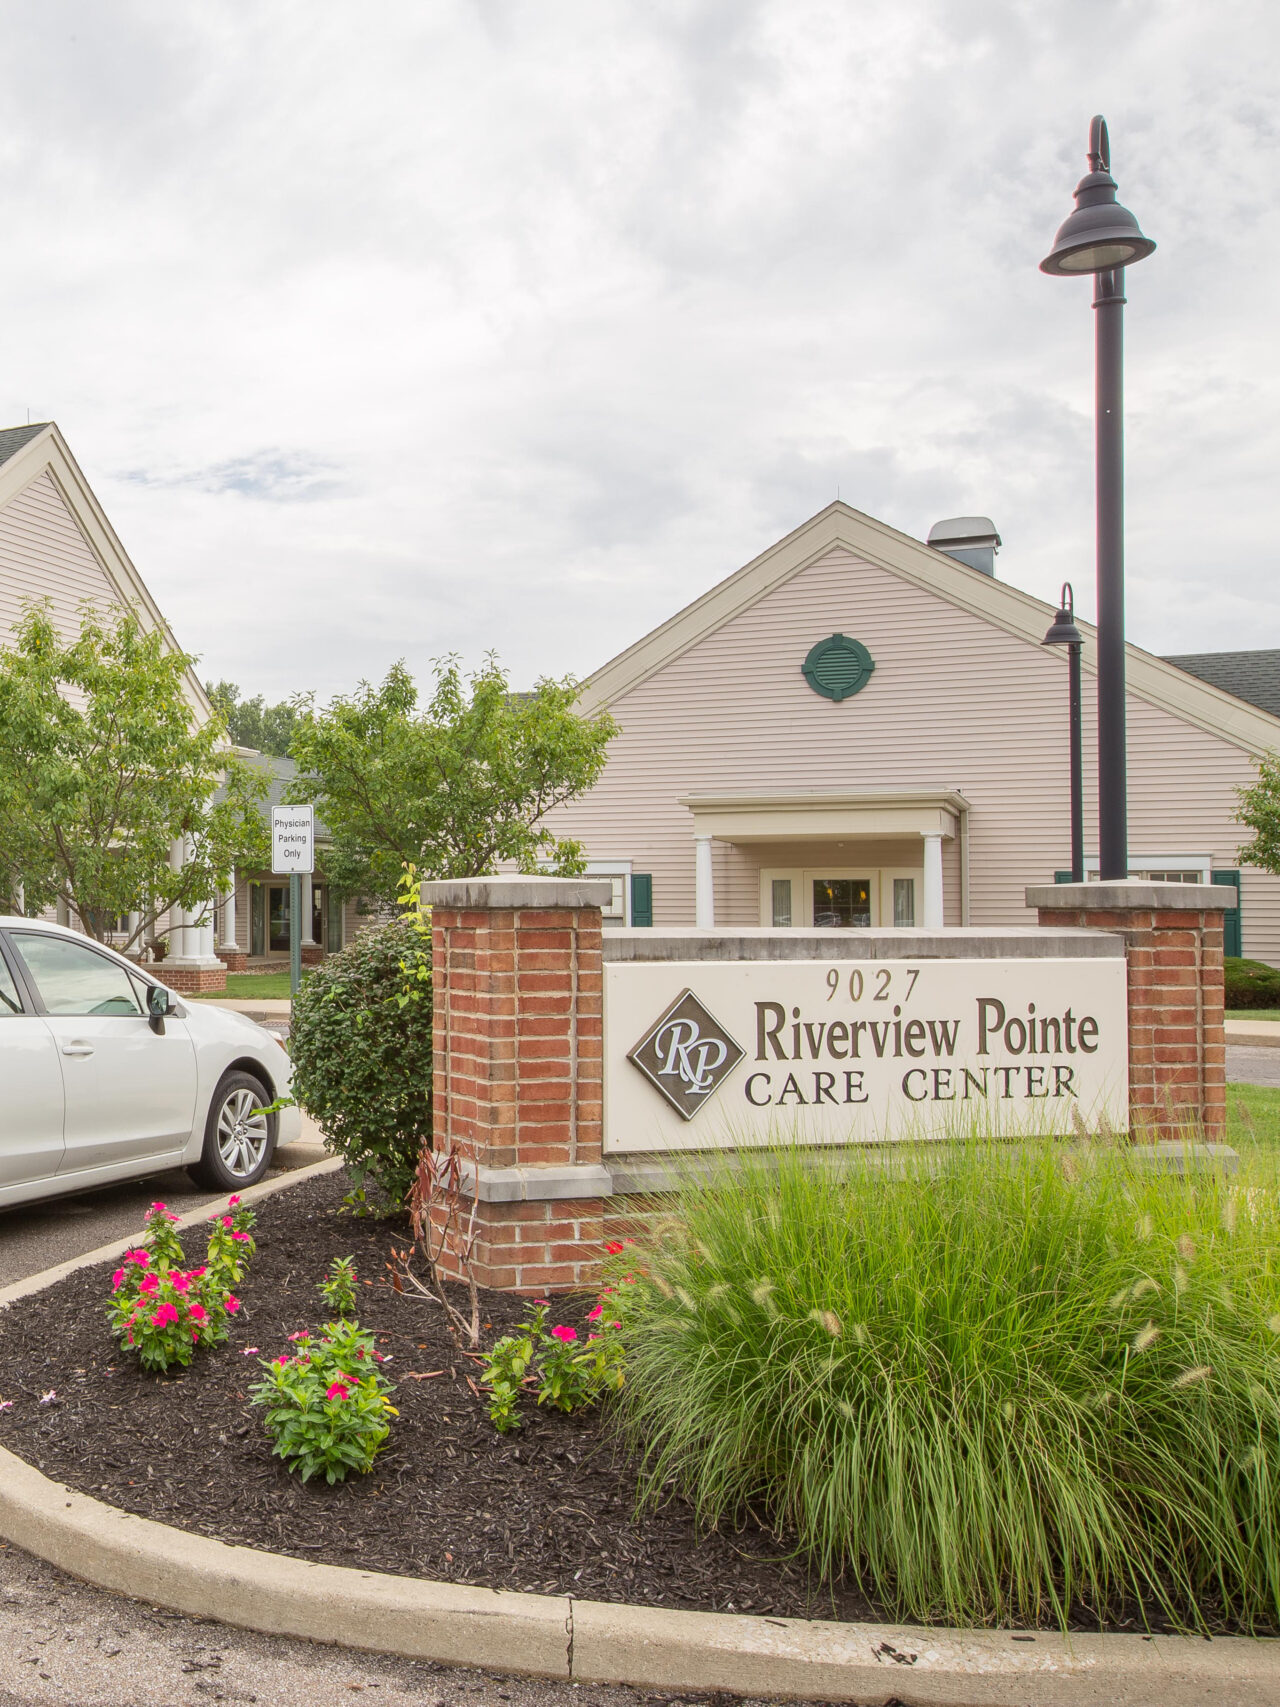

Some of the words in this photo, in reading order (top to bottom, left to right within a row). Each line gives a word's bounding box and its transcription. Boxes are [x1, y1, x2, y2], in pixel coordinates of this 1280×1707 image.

[274, 819, 310, 829] Physician
[278, 834, 306, 844] Parking
[283, 849, 300, 859] Only
[826, 968, 922, 1002] 9027
[754, 1001, 961, 1061] Riverview
[976, 996, 1100, 1056] Pointe
[744, 1070, 869, 1107] CARE
[901, 1065, 1079, 1102] CENTER
